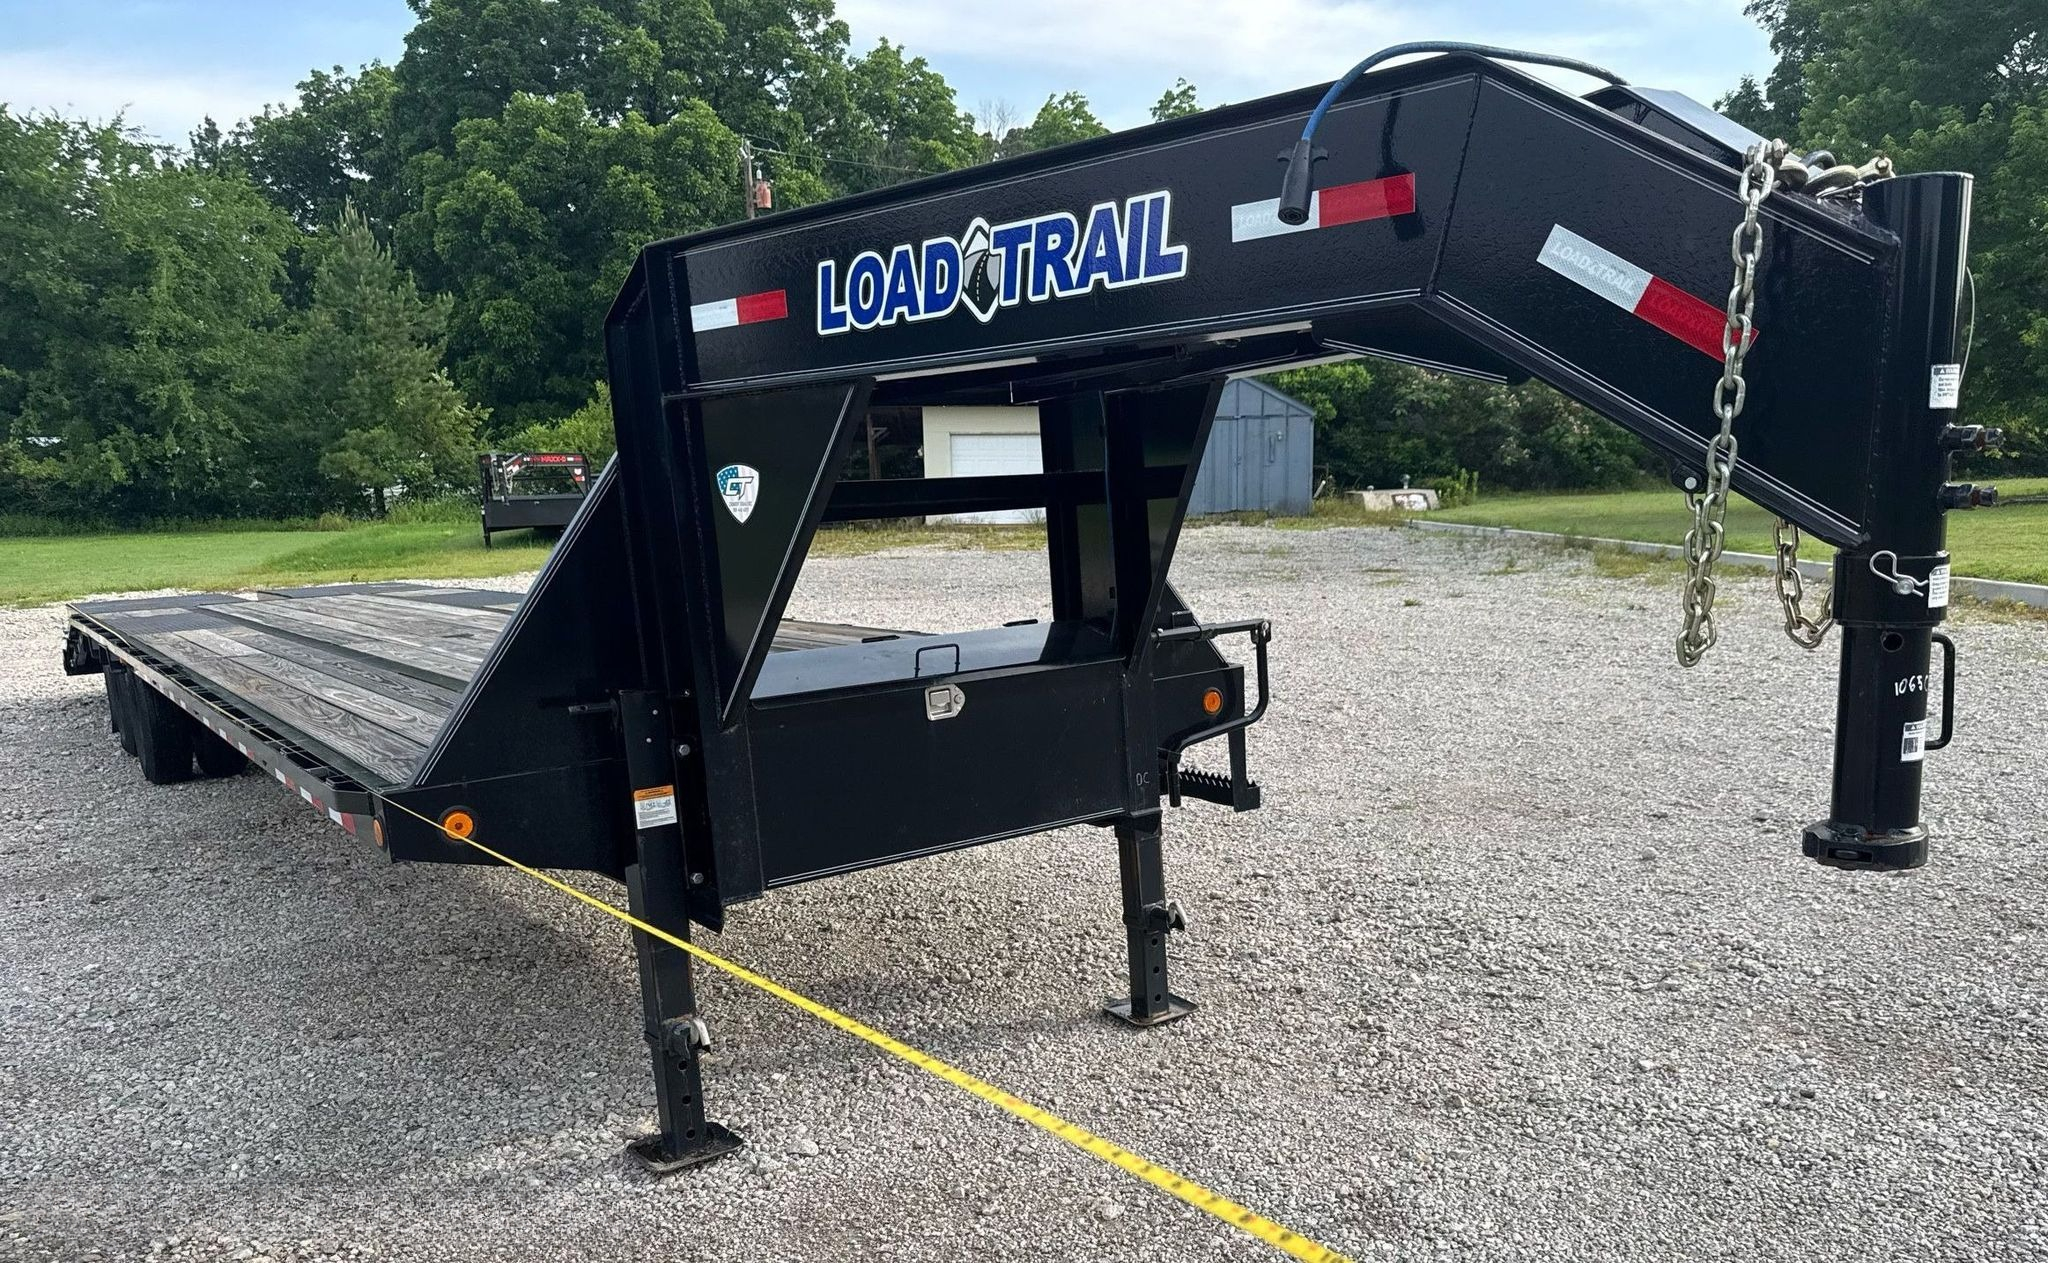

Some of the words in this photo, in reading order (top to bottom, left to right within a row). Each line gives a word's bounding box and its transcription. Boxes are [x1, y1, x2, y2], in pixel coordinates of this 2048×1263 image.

[817, 238, 965, 336] LOAD
[989, 190, 1188, 307] TRAIL
[1550, 241, 1592, 270] LOAD
[1594, 262, 1636, 298] TRAIL
